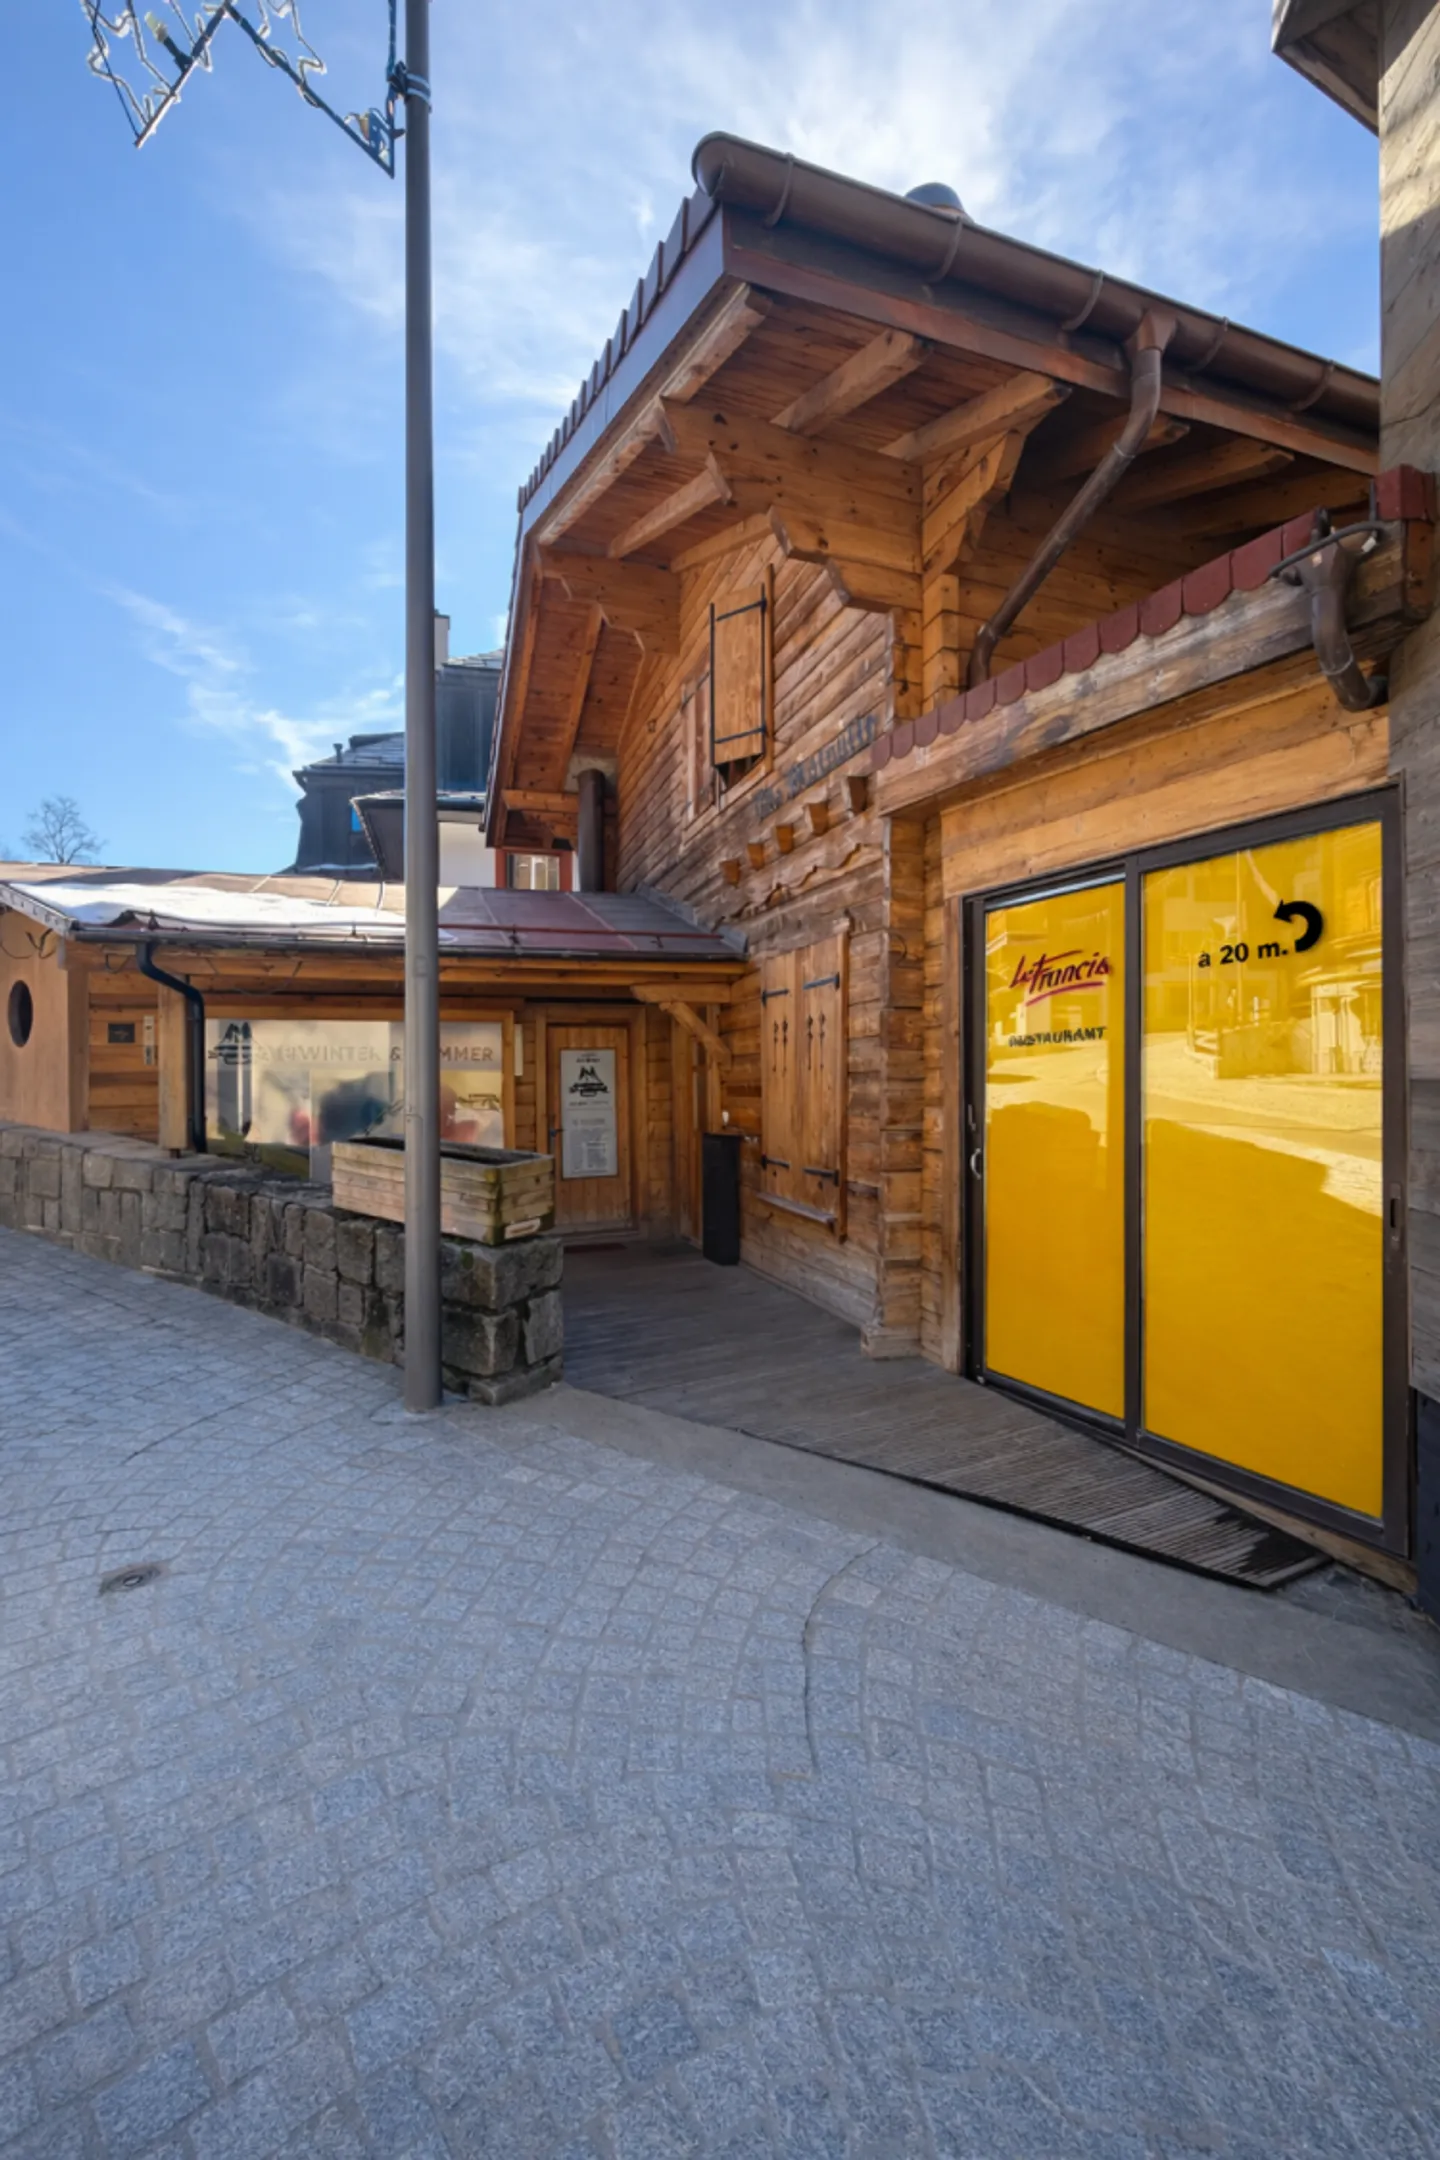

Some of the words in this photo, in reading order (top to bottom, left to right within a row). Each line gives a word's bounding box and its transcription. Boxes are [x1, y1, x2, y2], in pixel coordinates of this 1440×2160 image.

[1220, 942, 1249, 965] 20
[1257, 941, 1288, 959] m.
[389, 1046, 401, 1061] &
[439, 1046, 494, 1062] MMER
